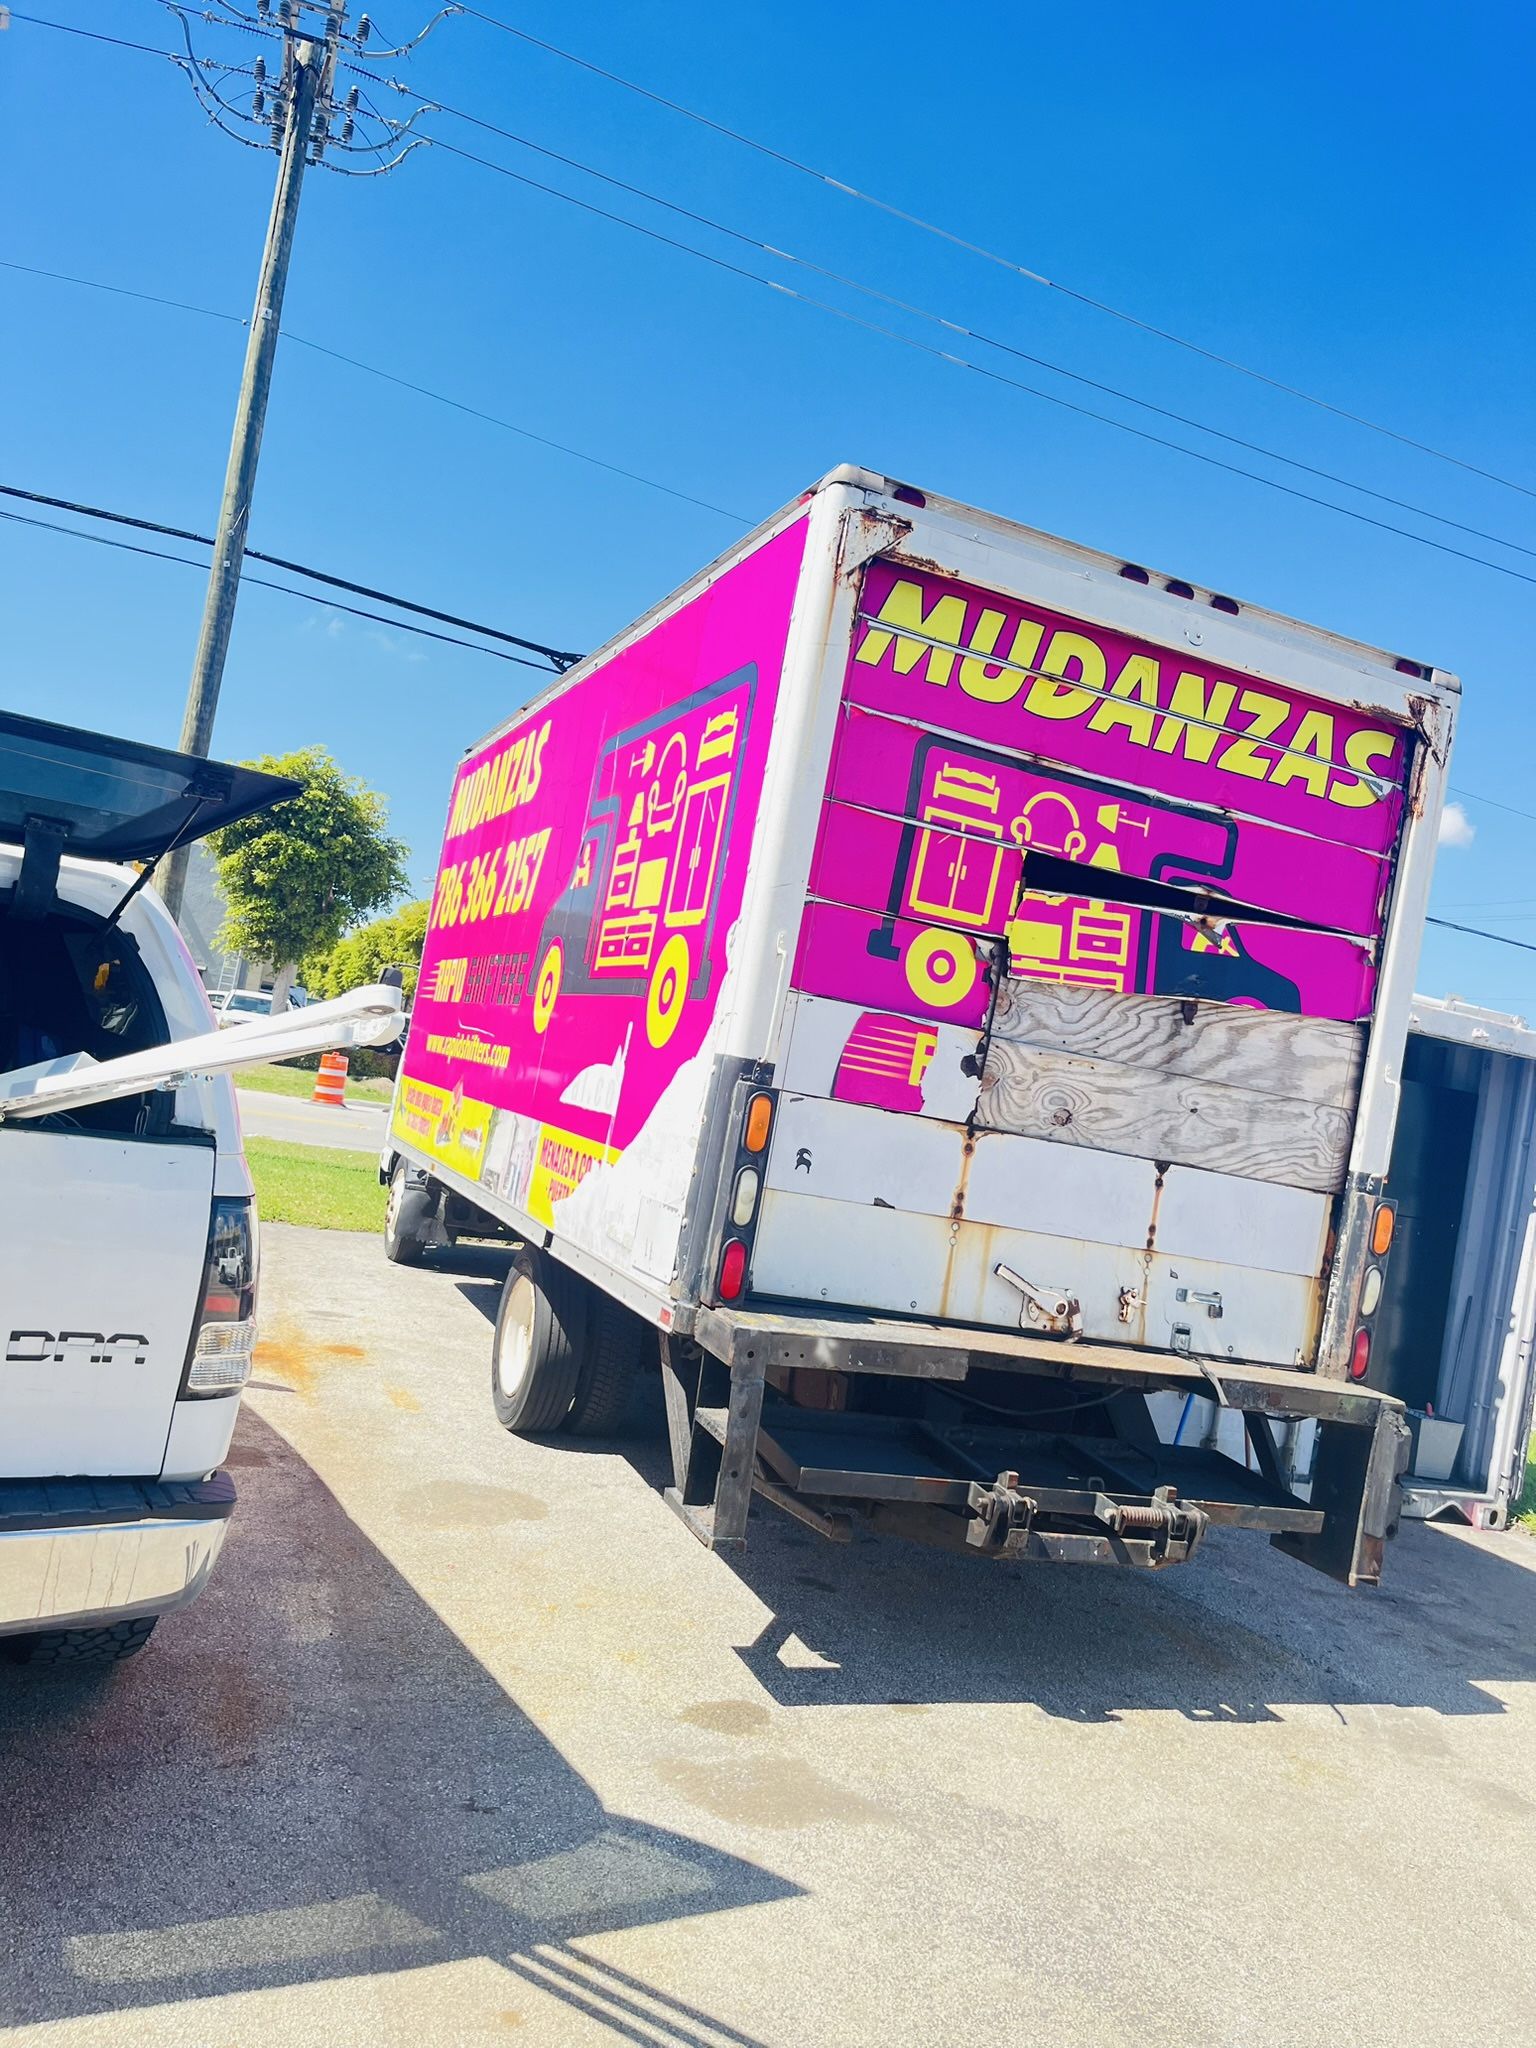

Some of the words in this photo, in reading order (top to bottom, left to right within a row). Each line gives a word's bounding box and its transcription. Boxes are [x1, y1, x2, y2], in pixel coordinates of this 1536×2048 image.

[856, 579, 1397, 808] MUDANZAS
[446, 719, 552, 841] MUDANZAS
[431, 860, 467, 930] 786
[460, 847, 502, 925] 366
[492, 827, 553, 917] 2157
[433, 957, 468, 1003] RAPID
[463, 951, 529, 1006] SHIFTERS
[426, 1032, 511, 1069] www.rapidshifters.com
